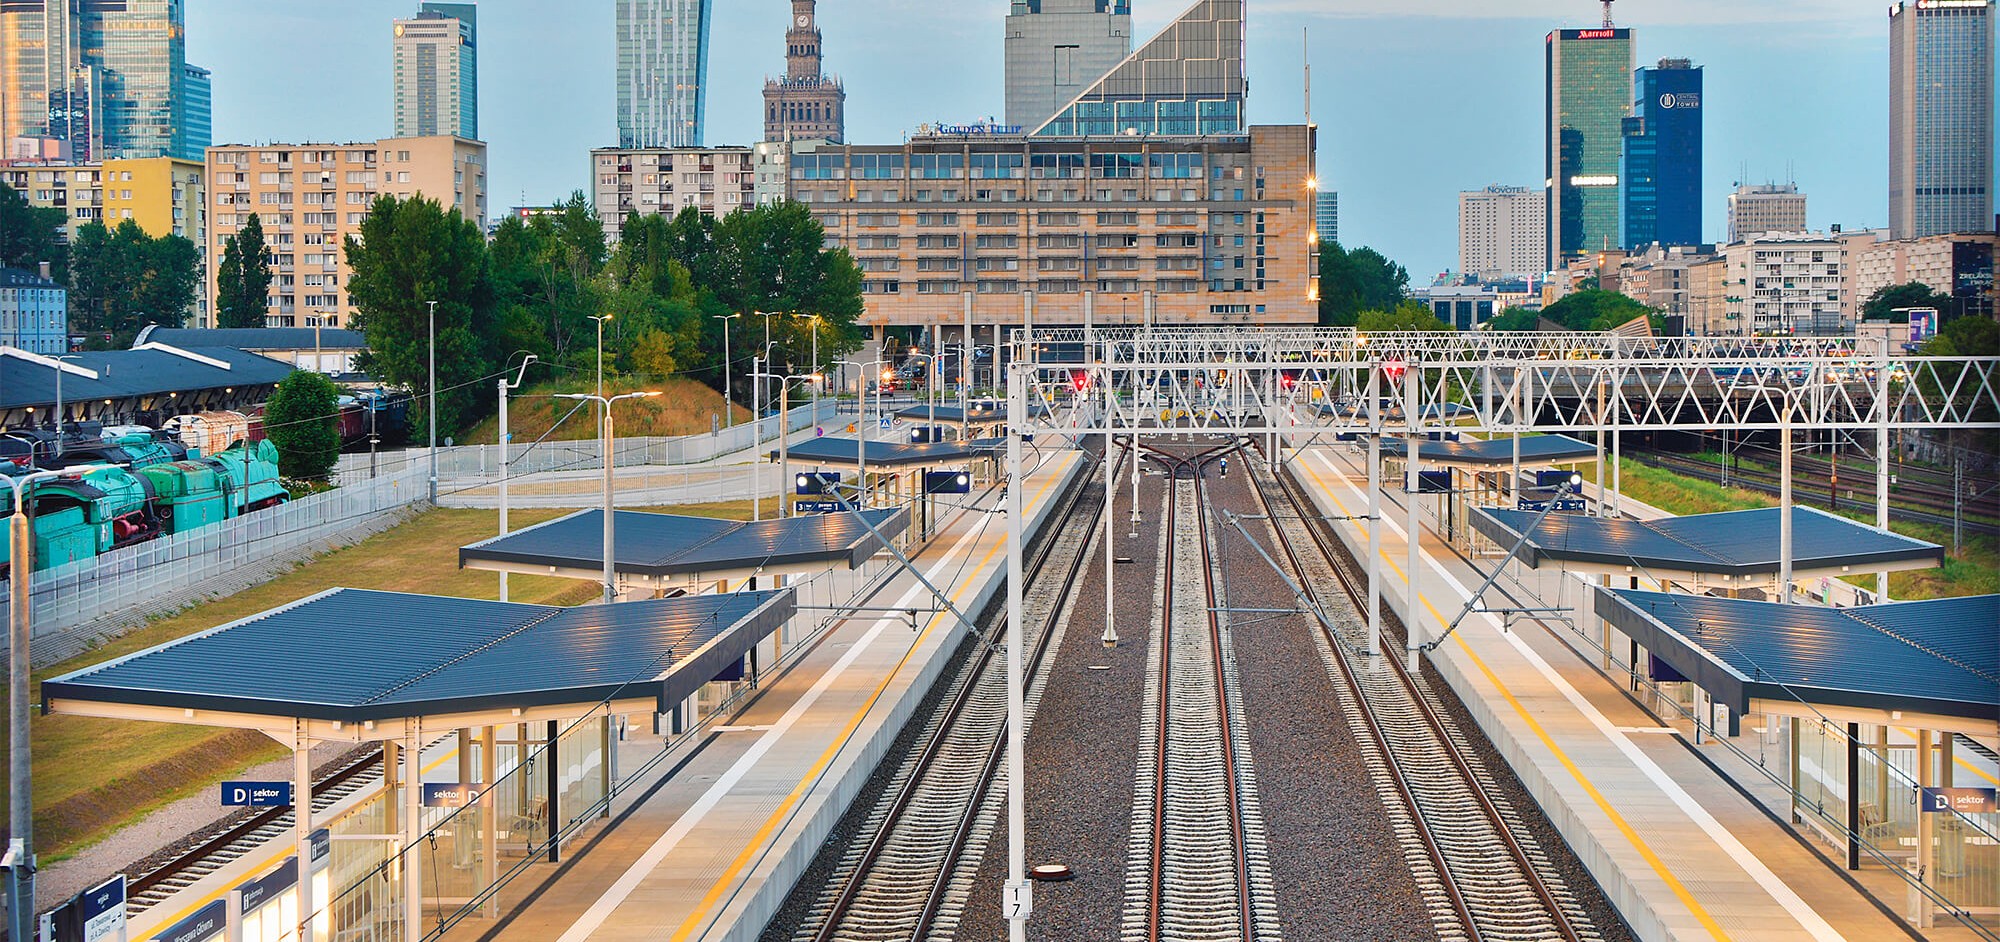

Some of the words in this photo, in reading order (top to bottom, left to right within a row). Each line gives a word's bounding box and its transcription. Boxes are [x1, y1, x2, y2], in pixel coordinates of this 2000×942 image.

[1578, 29, 1614, 39] Marriott
[939, 124, 986, 135] GOLDEN
[988, 124, 1022, 134] TULIP
[1487, 186, 1527, 194] NOVOTEL
[798, 503, 803, 511] 3
[834, 503, 839, 511] 1
[1556, 502, 1563, 510] 2
[233, 788, 247, 803] D
[253, 789, 280, 797] sektor
[433, 790, 460, 799] sektor
[467, 790, 481, 805] D
[1935, 794, 1949, 809] D
[1956, 795, 1985, 804] sektor
[1014, 887, 1018, 901] 1
[1012, 903, 1021, 917] 7
